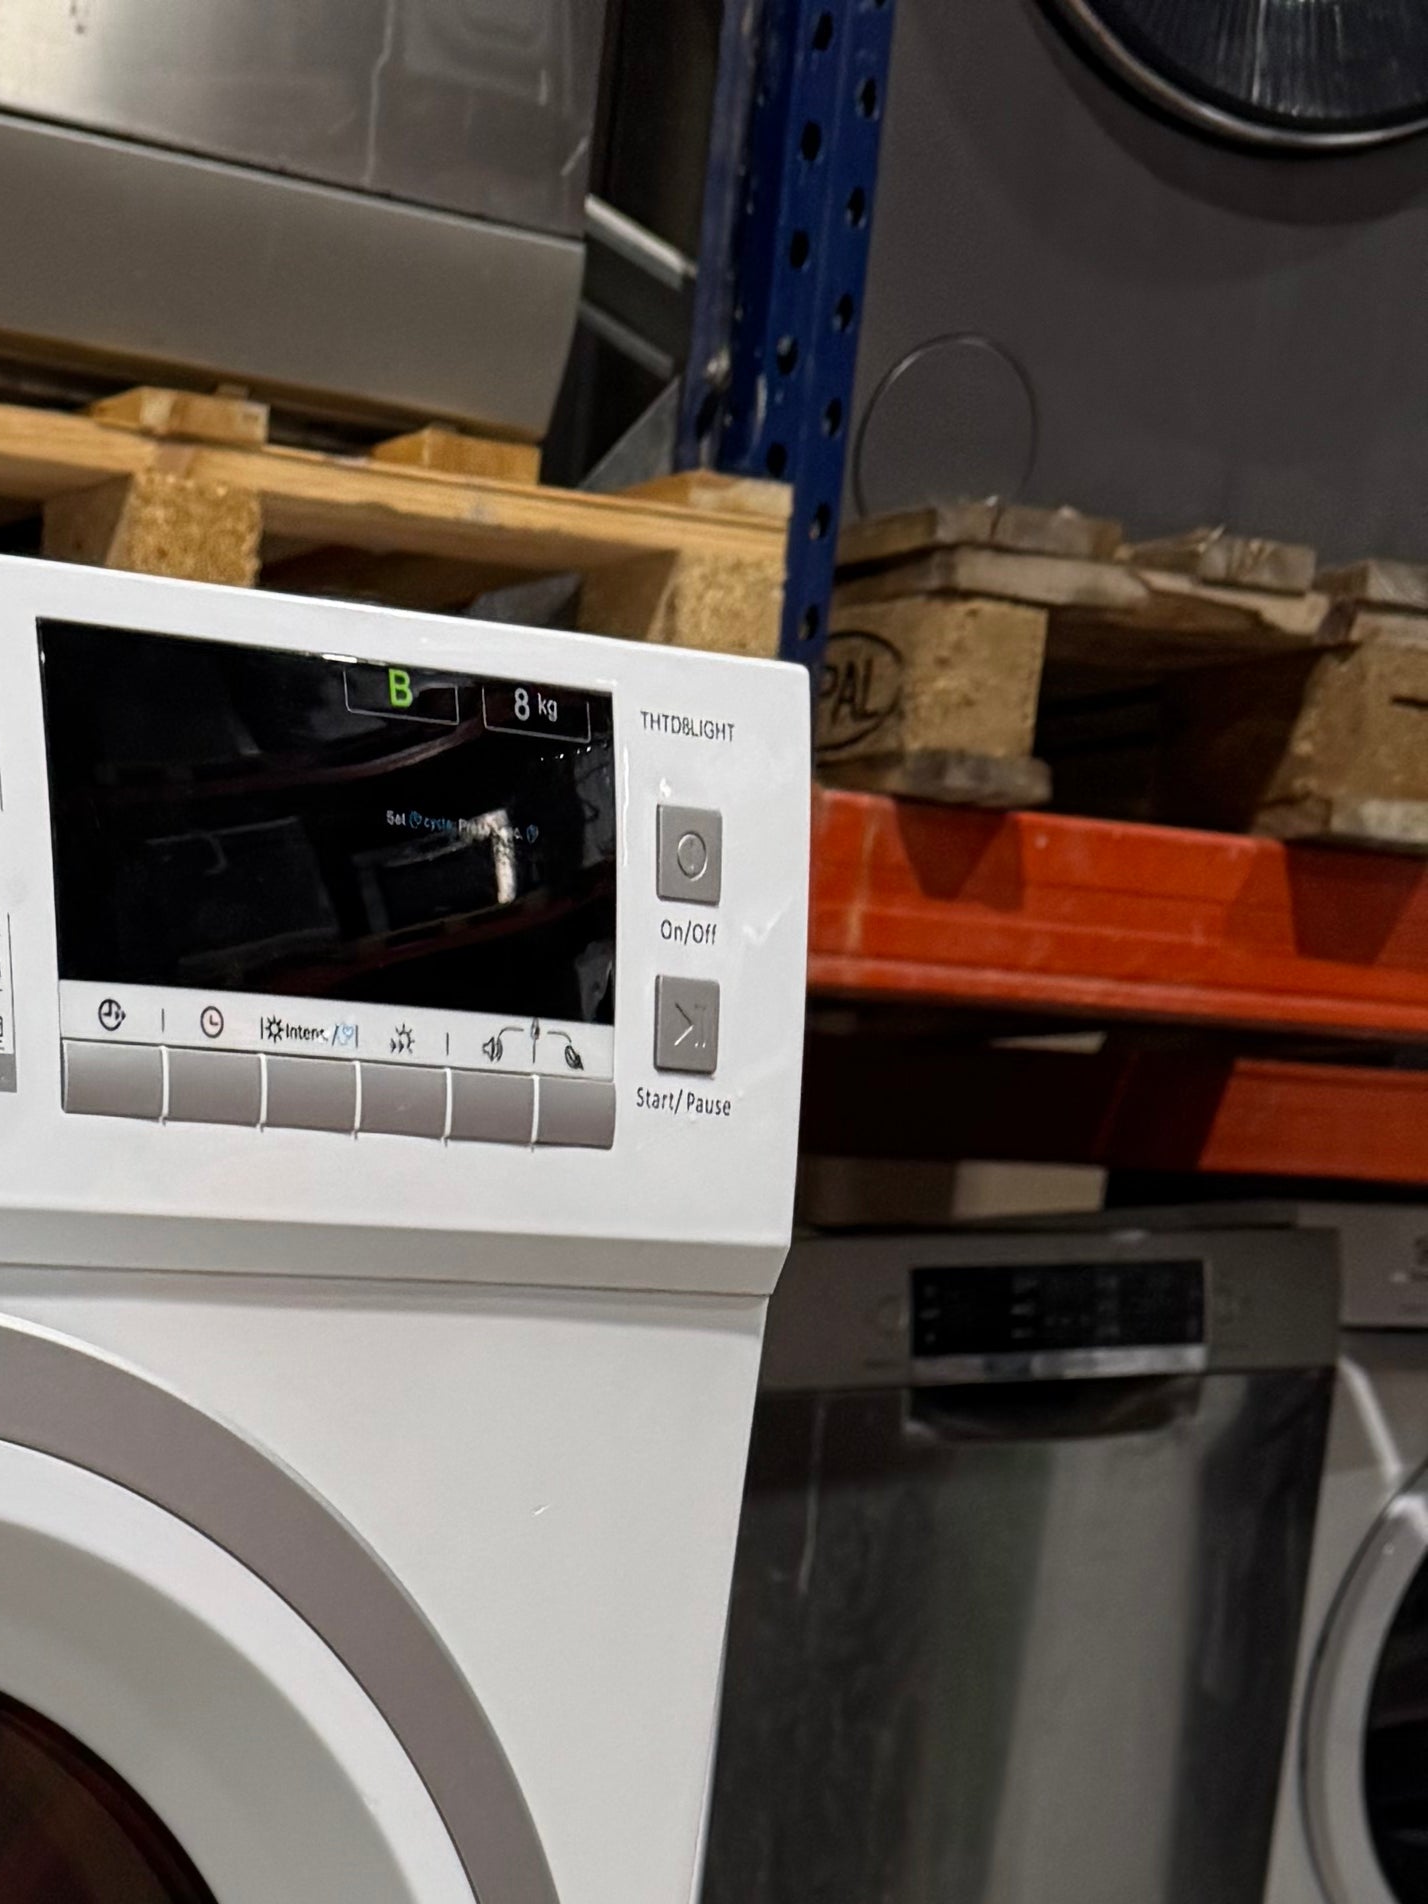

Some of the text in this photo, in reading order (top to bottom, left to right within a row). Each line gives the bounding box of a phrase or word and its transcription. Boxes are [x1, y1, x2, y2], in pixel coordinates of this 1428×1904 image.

[387, 669, 414, 708] B
[513, 688, 558, 721] 8 kg
[660, 919, 718, 945] On/Off
